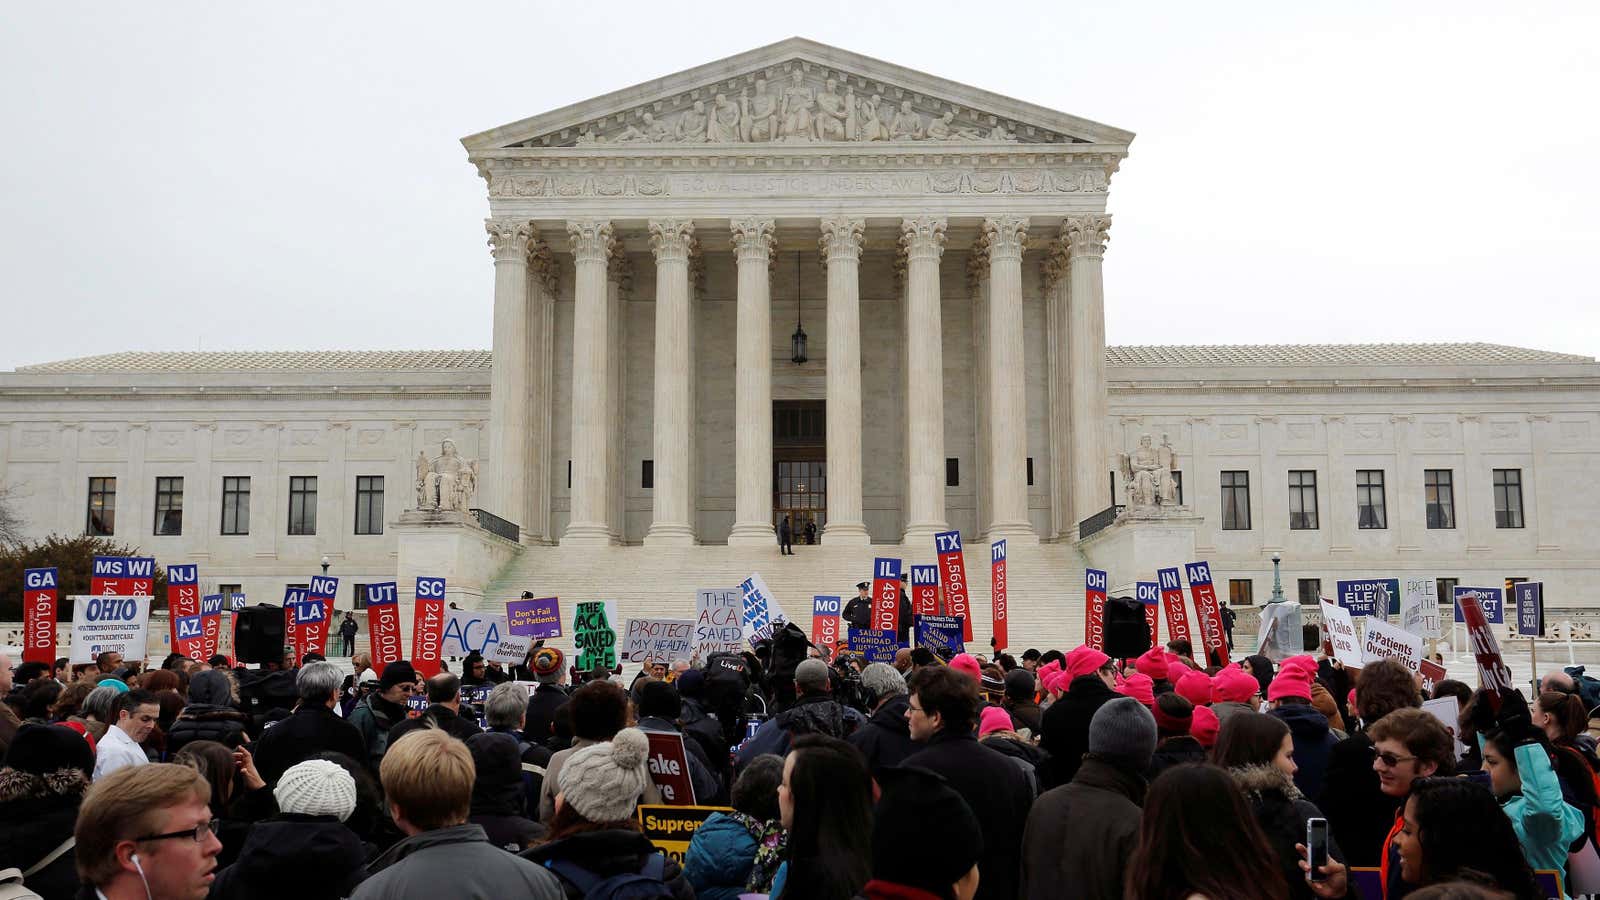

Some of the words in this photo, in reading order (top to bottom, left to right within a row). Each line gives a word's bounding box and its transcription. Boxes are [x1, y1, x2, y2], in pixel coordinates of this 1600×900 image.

[937, 534, 960, 550] TX
[992, 542, 1005, 560] TN
[95, 561, 123, 574] MS
[128, 560, 152, 576] WI
[170, 567, 195, 582] NJ
[880, 561, 895, 577] IL
[914, 568, 935, 583] MI
[1189, 566, 1210, 582] AR
[27, 572, 55, 587] GA
[312, 579, 336, 595] NC
[946, 555, 966, 620] 1,566,000
[1087, 573, 1105, 588] OH
[1161, 571, 1177, 589] IN
[1354, 583, 1389, 591] DIDNT
[134, 581, 148, 596] 28
[368, 585, 395, 602] UT
[418, 580, 443, 596] SC
[997, 564, 1005, 619] 320,000
[1139, 585, 1157, 600] OK
[179, 588, 195, 616] 237,
[232, 597, 244, 610] KS
[702, 592, 737, 608] THE
[743, 589, 763, 610] AKE
[1344, 591, 1394, 603] ELET
[87, 599, 137, 621] OHIO
[204, 599, 222, 612] WY
[298, 604, 321, 621] LA
[577, 602, 601, 613] THE
[815, 600, 838, 612] MO
[880, 582, 895, 630] 438,00
[34, 593, 51, 648] 461,000
[515, 610, 535, 618] Don't
[526, 616, 557, 624] Patients
[576, 613, 606, 630] ACA
[698, 608, 738, 626] ACA
[1169, 594, 1186, 641] 225,00
[180, 619, 200, 636] AZ
[422, 603, 438, 661] 241,000
[629, 620, 694, 637] PROTECT
[696, 626, 741, 641] SAVED
[859, 629, 883, 637] SALUD
[929, 627, 948, 643] SALUD
[1331, 618, 1351, 636] Take
[304, 626, 320, 656] 214,
[379, 608, 397, 664] 162,000
[441, 618, 499, 654] ACA
[575, 630, 615, 648] SAVED
[852, 637, 891, 645] DIGNIDAD
[1368, 630, 1413, 656] #Patients
[586, 647, 605, 657] MY
[631, 639, 651, 649] MY
[654, 640, 689, 652] HEALTH
[630, 651, 677, 662] CARE
[720, 660, 744, 671] LiveU
[649, 754, 680, 775] ake
